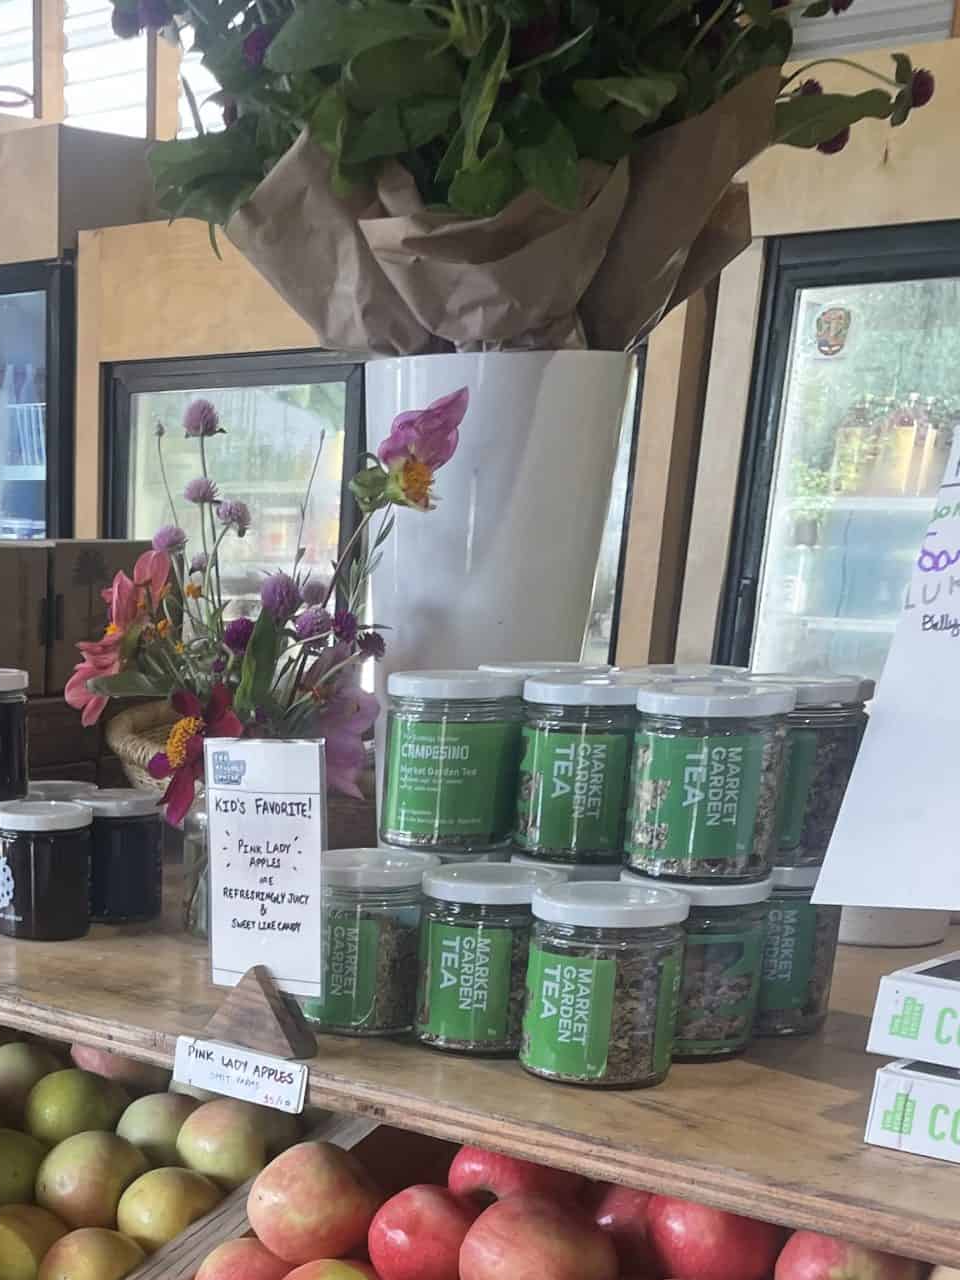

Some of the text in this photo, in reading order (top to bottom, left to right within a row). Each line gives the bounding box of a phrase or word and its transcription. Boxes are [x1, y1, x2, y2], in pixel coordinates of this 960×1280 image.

[551, 742, 576, 798] TEA
[570, 743, 591, 819] GARDEN
[588, 743, 608, 819] MARKET
[681, 746, 709, 808] TEA
[705, 746, 728, 827] GARDEN
[722, 747, 743, 825] MARKET
[215, 796, 313, 819] KID'S FAVORITE!
[238, 839, 292, 854] PINK LADY
[248, 857, 281, 868] APPLES
[223, 886, 286, 905] REFRESHINGLY
[231, 917, 256, 931] SWEET
[329, 926, 345, 997] GARDEN
[343, 927, 359, 997] MARKET
[439, 935, 461, 990] TEA
[458, 936, 477, 1011] GARDEN
[473, 937, 492, 1012] MARKET
[761, 909, 783, 981] GARDEN
[777, 909, 800, 981] MARKET
[539, 964, 562, 1019] TEA
[557, 965, 577, 1044] GARDEN
[571, 967, 593, 1046] MARKET
[188, 1044, 294, 1084] PINK LADY APPLES
